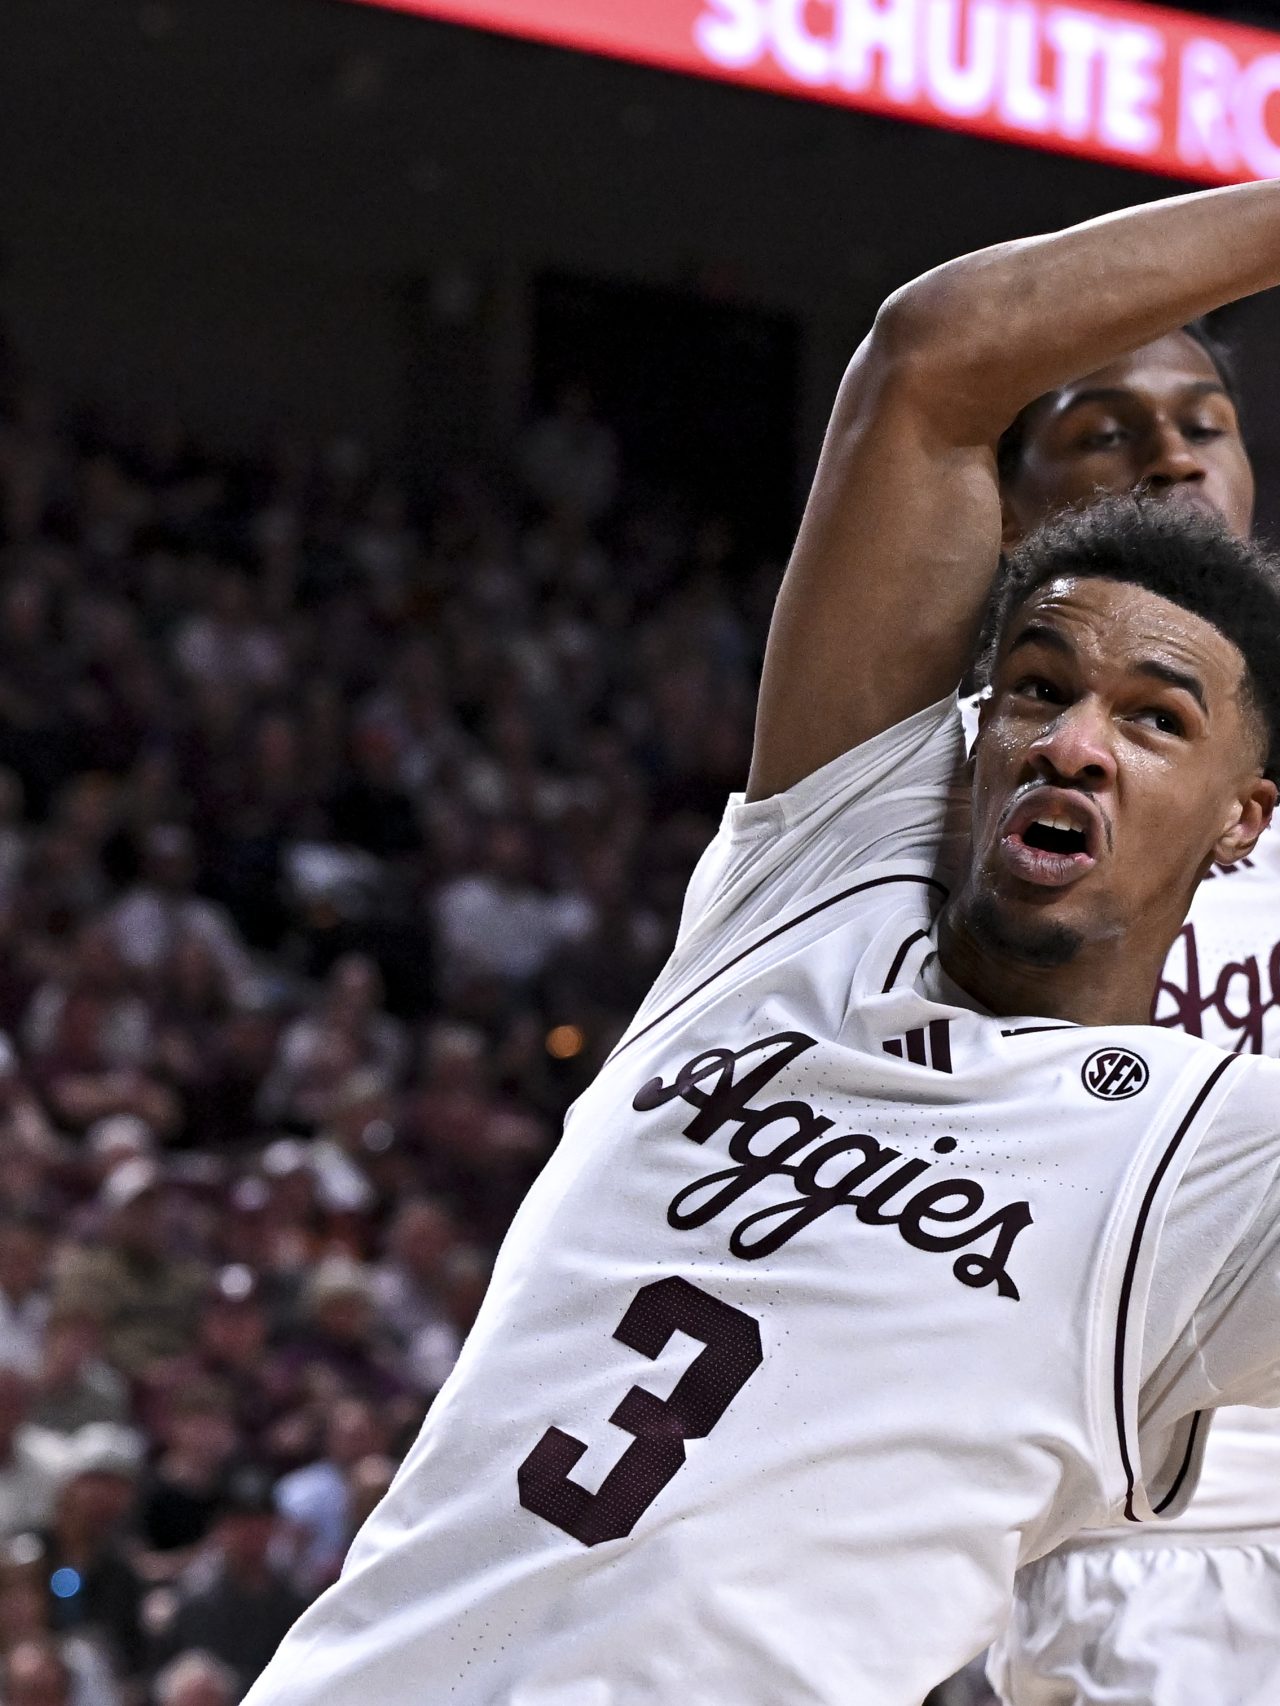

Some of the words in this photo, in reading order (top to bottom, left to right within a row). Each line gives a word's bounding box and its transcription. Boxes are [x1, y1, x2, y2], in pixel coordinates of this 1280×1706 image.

[693, 0, 1164, 155] SCHULTE
[633, 1030, 1035, 1301] Aggies
[1088, 1052, 1143, 1096] SEC
[517, 1274, 764, 1548] 3
